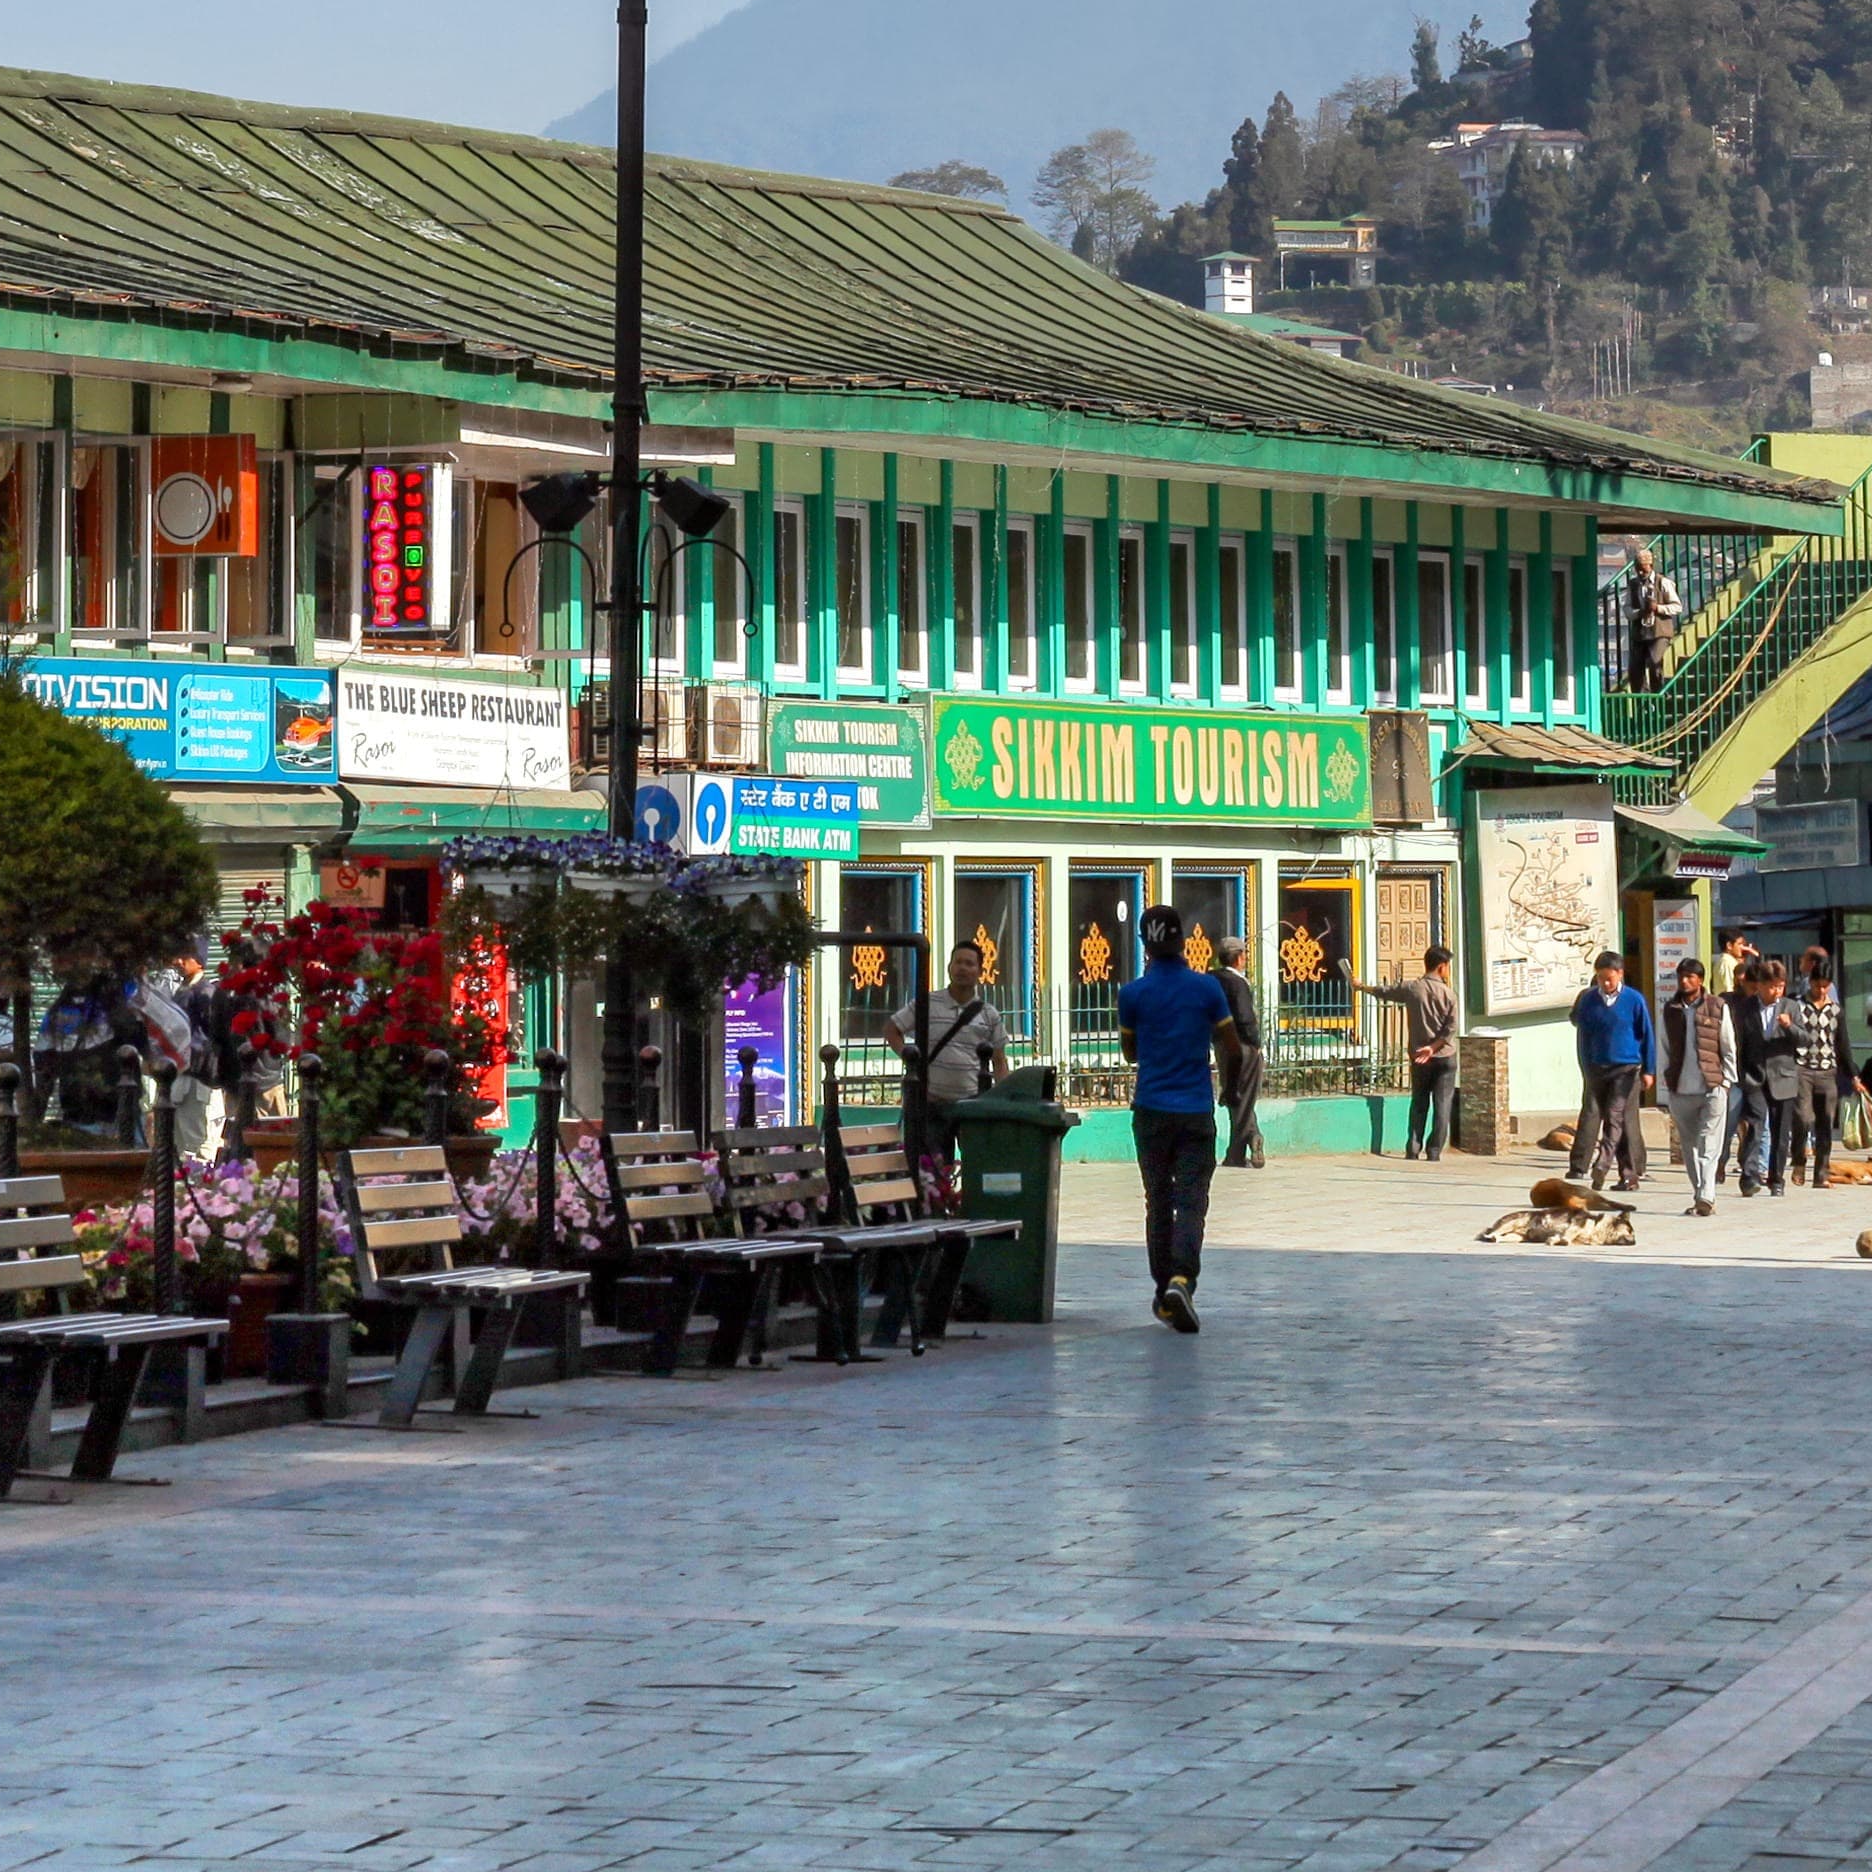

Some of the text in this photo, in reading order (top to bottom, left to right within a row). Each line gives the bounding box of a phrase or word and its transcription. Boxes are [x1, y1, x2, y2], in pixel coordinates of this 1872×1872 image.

[370, 468, 401, 627] RASOI
[345, 682, 562, 729] THE BLUE SHEEP RESTAURANT
[794, 719, 898, 746] SIKKIM TOURISM
[786, 752, 913, 779] INFORMATION CENTRE
[991, 716, 1136, 805] SIKKIM
[1150, 724, 1321, 809] TOURISM
[771, 783, 796, 808] बैंक
[800, 792, 810, 811] ए
[812, 785, 827, 810] टी
[831, 793, 851, 813] एम
[738, 825, 852, 852] STATE BANK ATM
